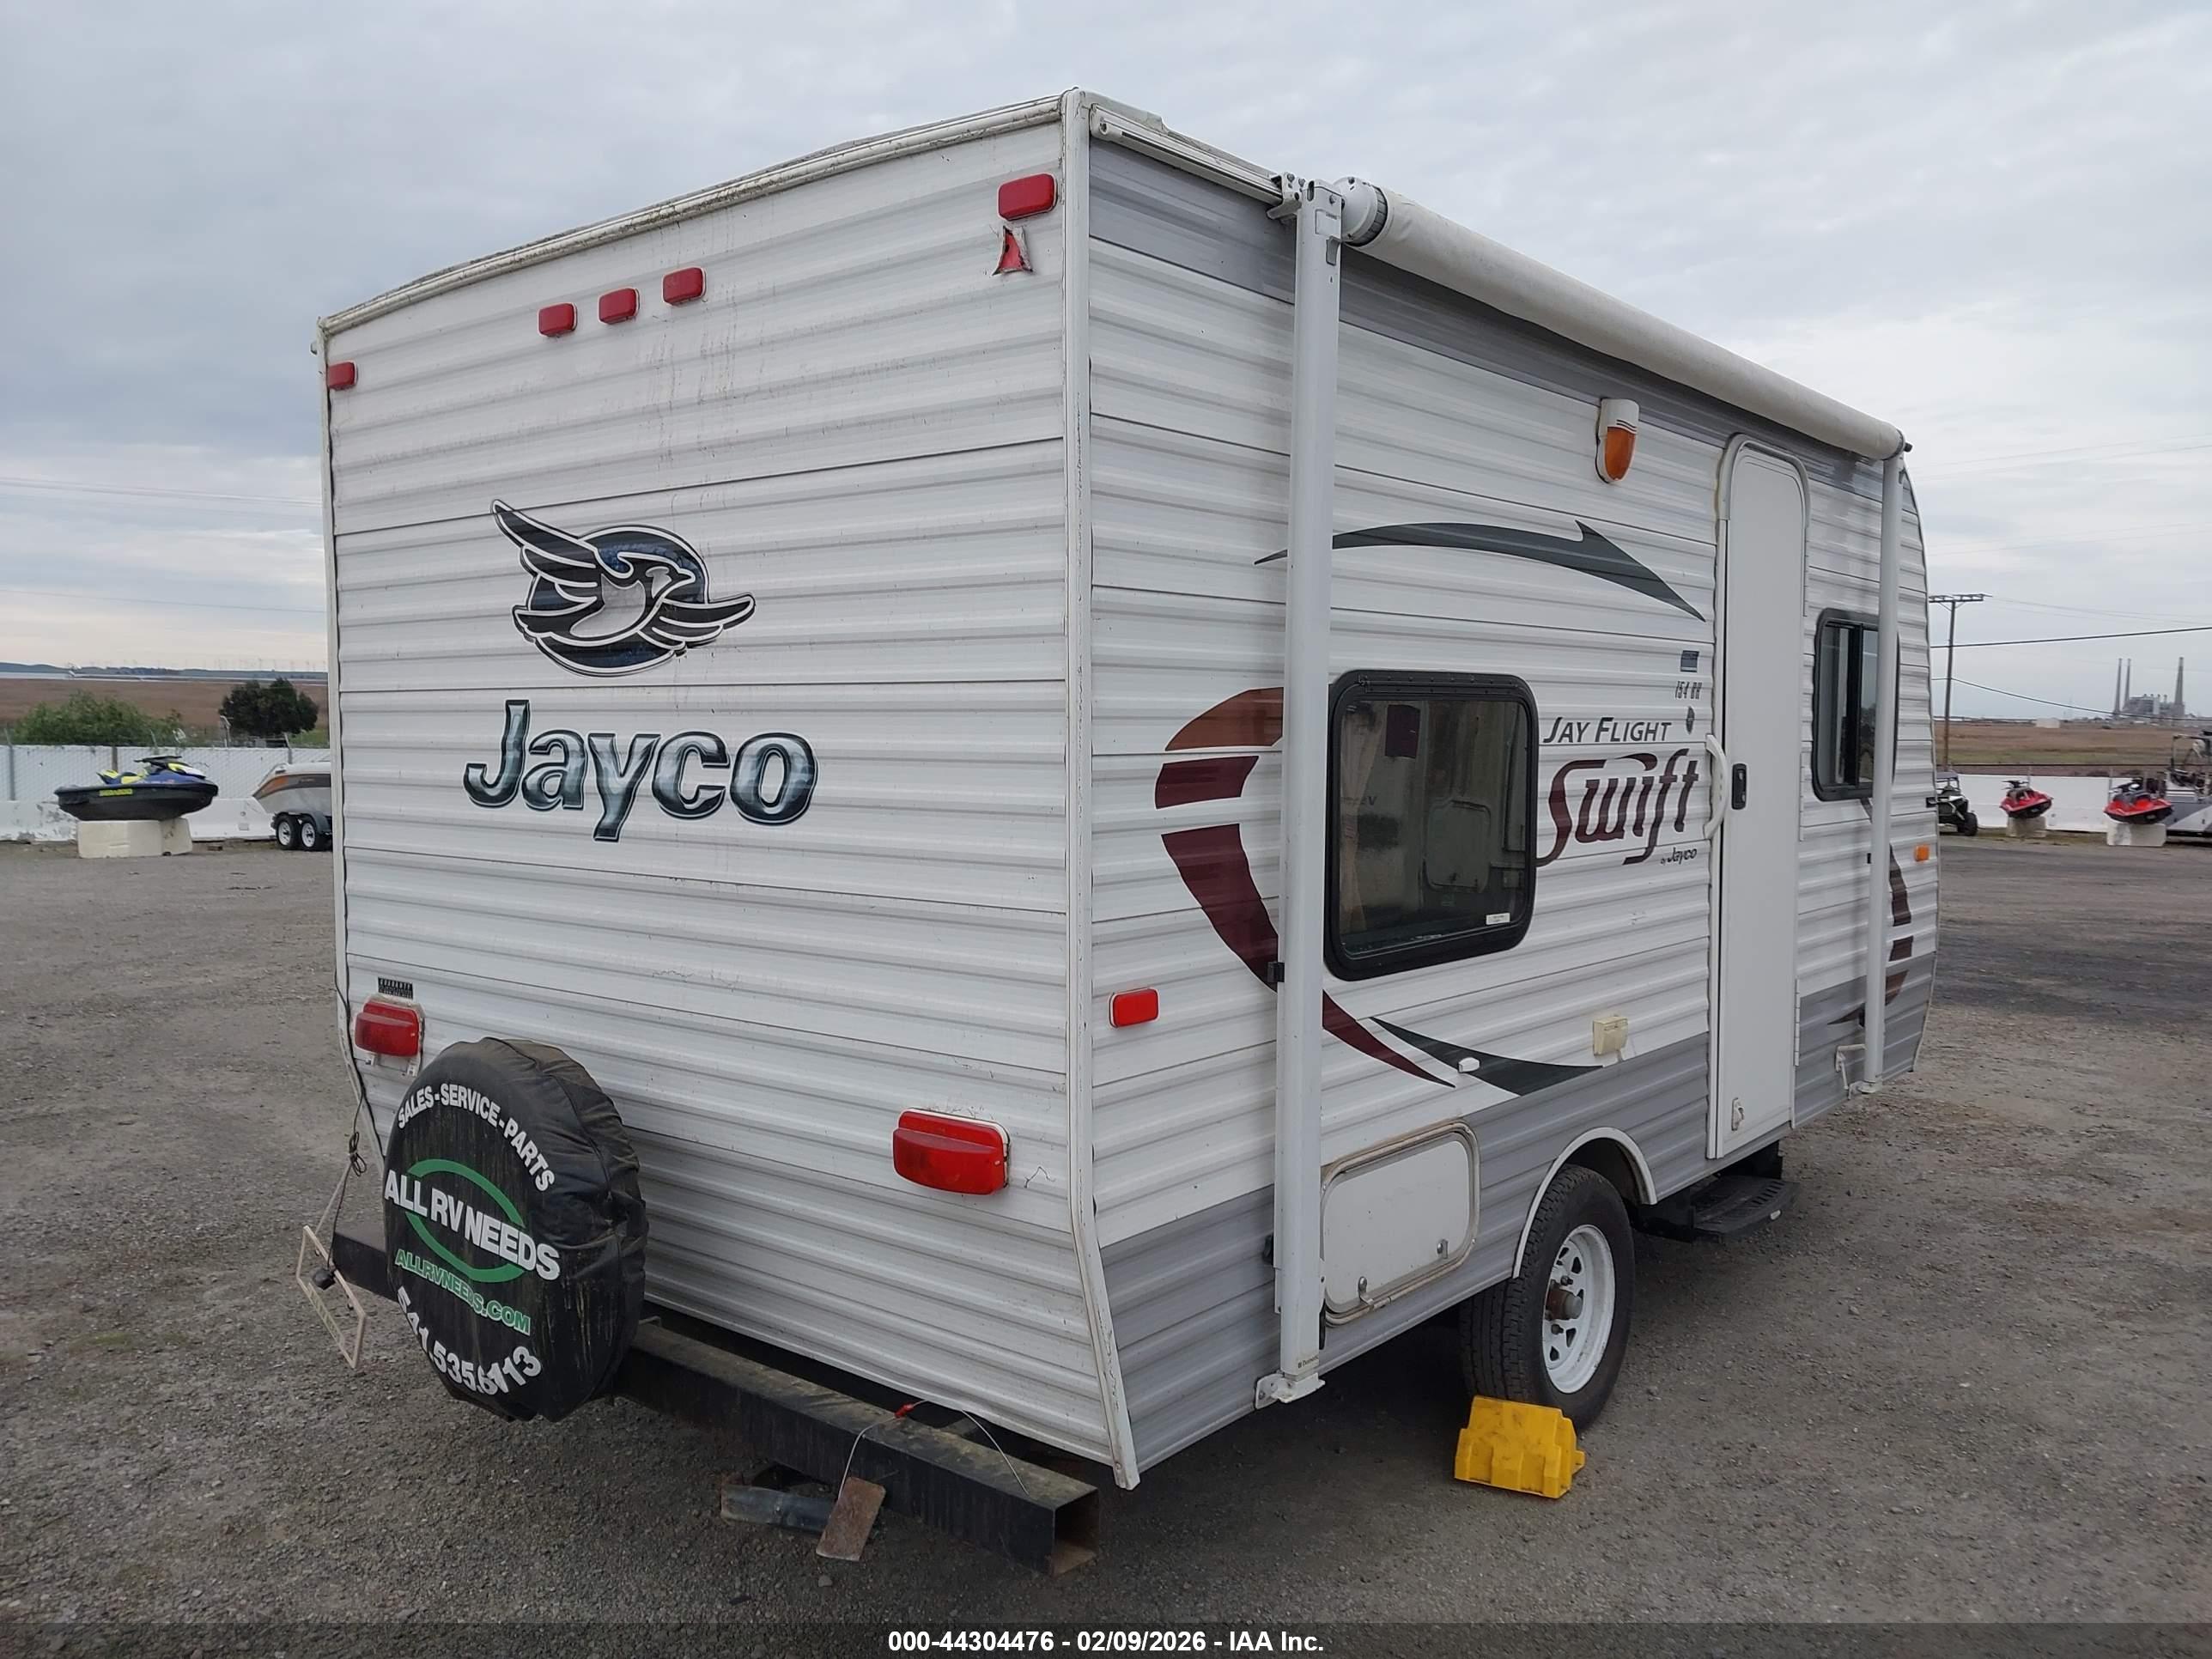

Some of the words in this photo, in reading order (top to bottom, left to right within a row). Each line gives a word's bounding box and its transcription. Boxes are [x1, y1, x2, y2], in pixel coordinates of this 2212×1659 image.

[463, 699, 819, 843] Jayco
[1536, 748, 1699, 867] Swift
[384, 1169, 428, 1218] ALL
[430, 1188, 464, 1233] RV
[464, 1205, 561, 1281] NEEDS
[394, 1249, 531, 1336] ALLRVNEEDS.COM
